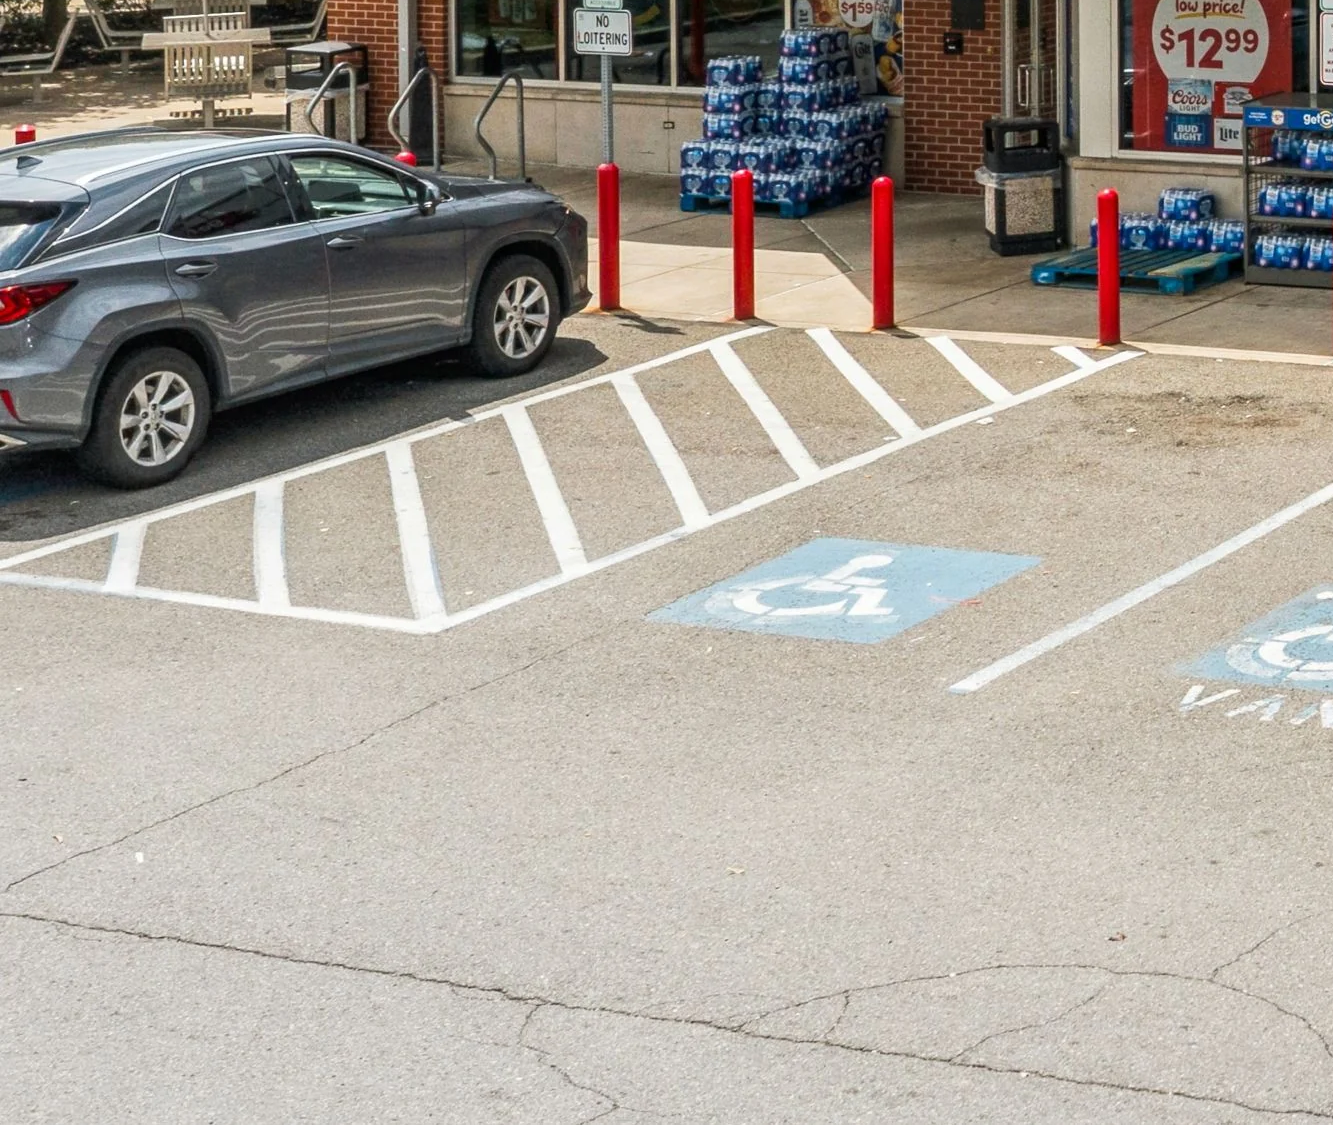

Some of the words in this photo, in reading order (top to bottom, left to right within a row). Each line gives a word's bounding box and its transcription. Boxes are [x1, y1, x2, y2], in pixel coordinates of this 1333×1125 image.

[595, 15, 609, 27] NO
[576, 31, 628, 46] LOITERING
[1171, 89, 1208, 105] Coors
[1177, 124, 1199, 132] BUD
[1219, 127, 1240, 142] Lite
[1173, 131, 1202, 142] LIGHT
